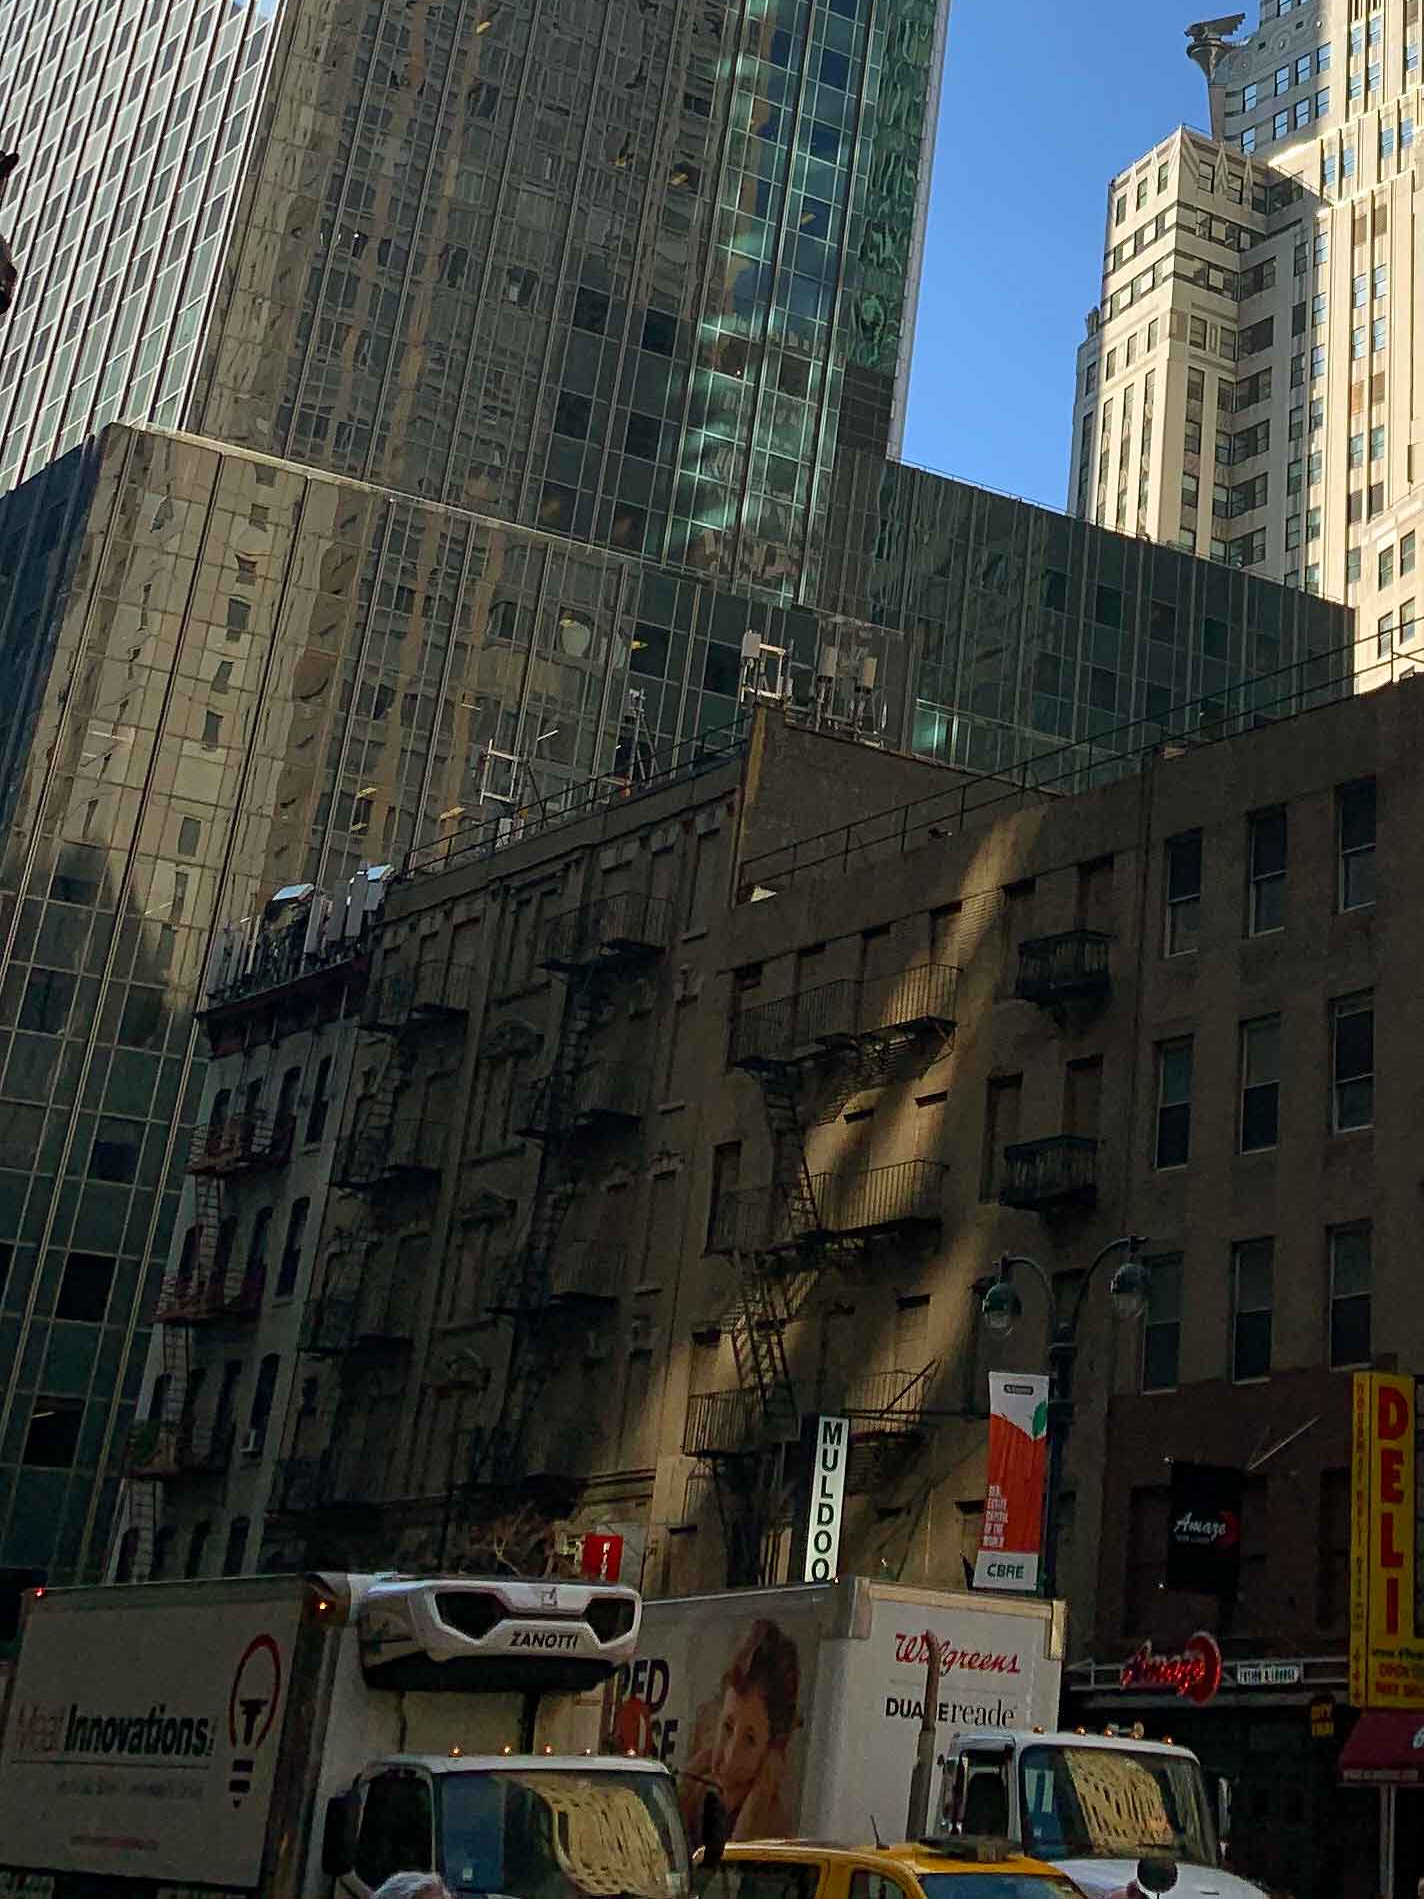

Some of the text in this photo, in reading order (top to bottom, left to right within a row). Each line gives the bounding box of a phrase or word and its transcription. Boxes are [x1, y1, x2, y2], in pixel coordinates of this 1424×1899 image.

[1378, 1387, 1408, 1634] DELI
[987, 1563, 1025, 1579] CBRE
[509, 1630, 578, 1650] ZANOTTI
[885, 1698, 948, 1723] DUAE
[64, 1703, 208, 1756] Innovations
